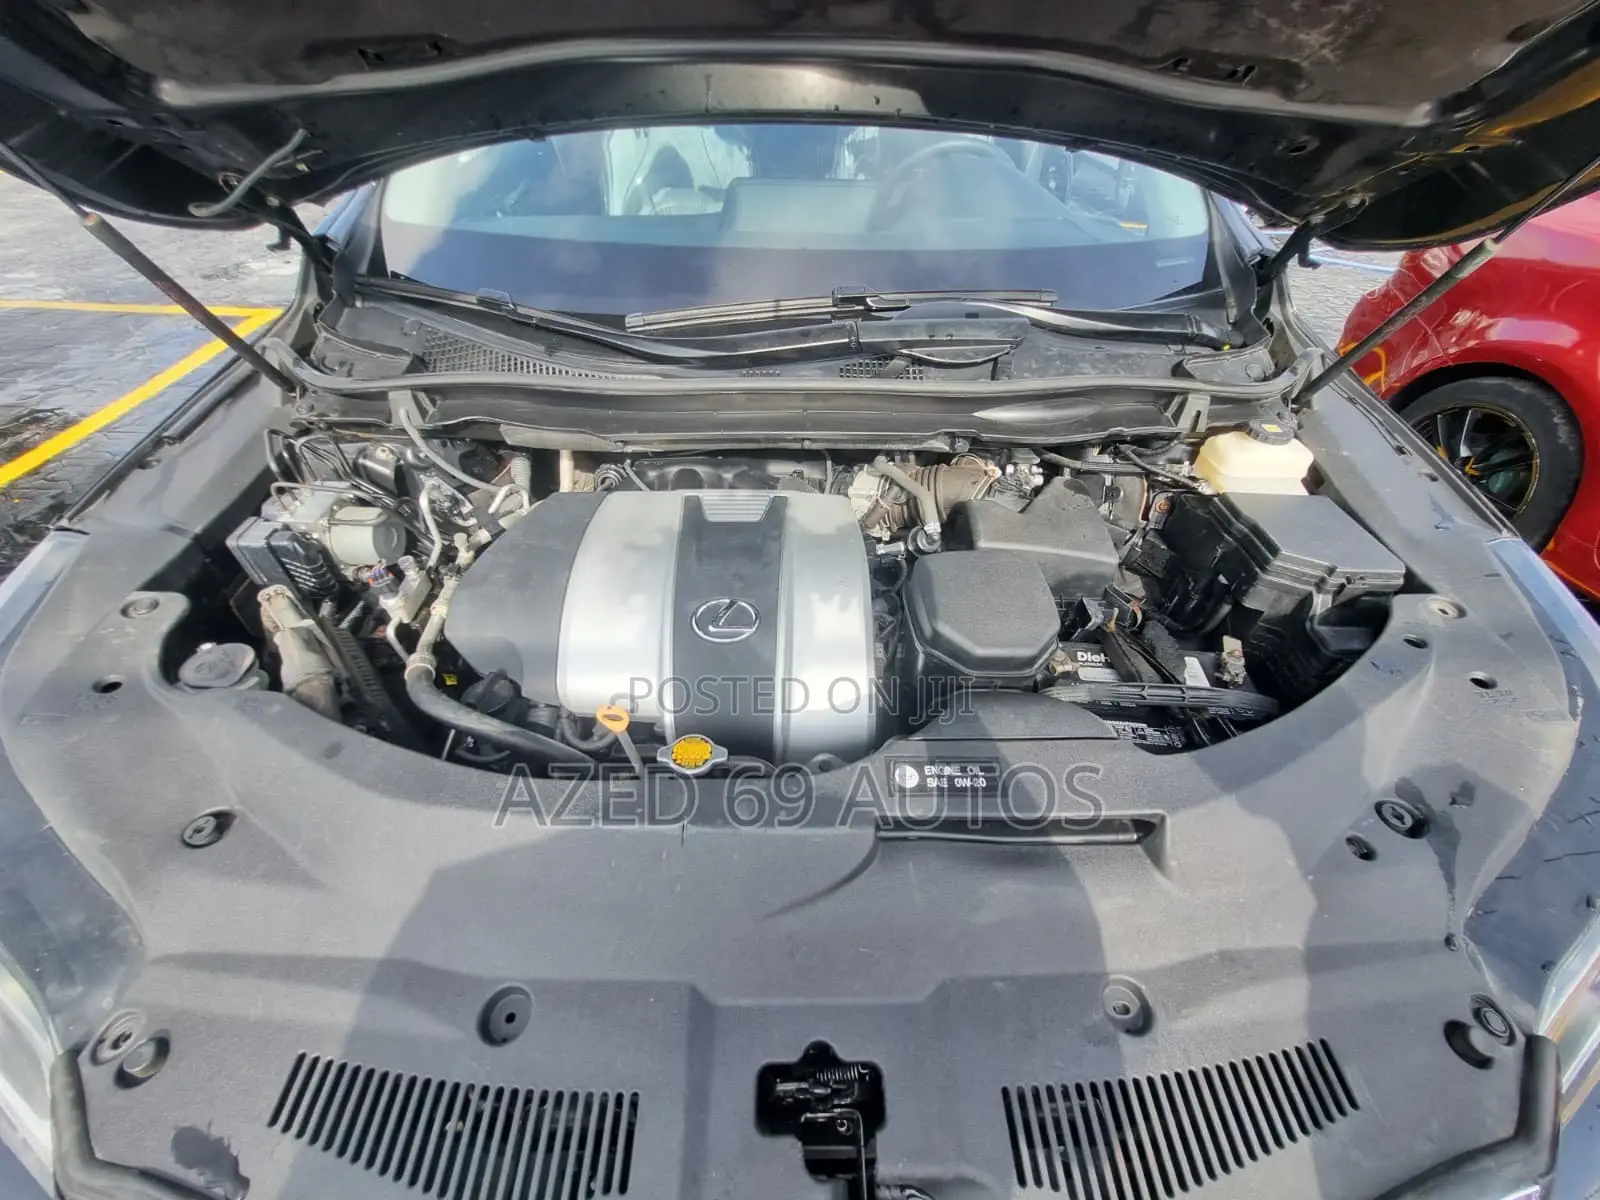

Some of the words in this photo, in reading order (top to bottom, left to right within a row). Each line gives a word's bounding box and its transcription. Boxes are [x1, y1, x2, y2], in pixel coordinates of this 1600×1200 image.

[924, 765, 962, 776] ENGINE
[967, 765, 985, 776] OIL
[926, 777, 949, 788] SAE
